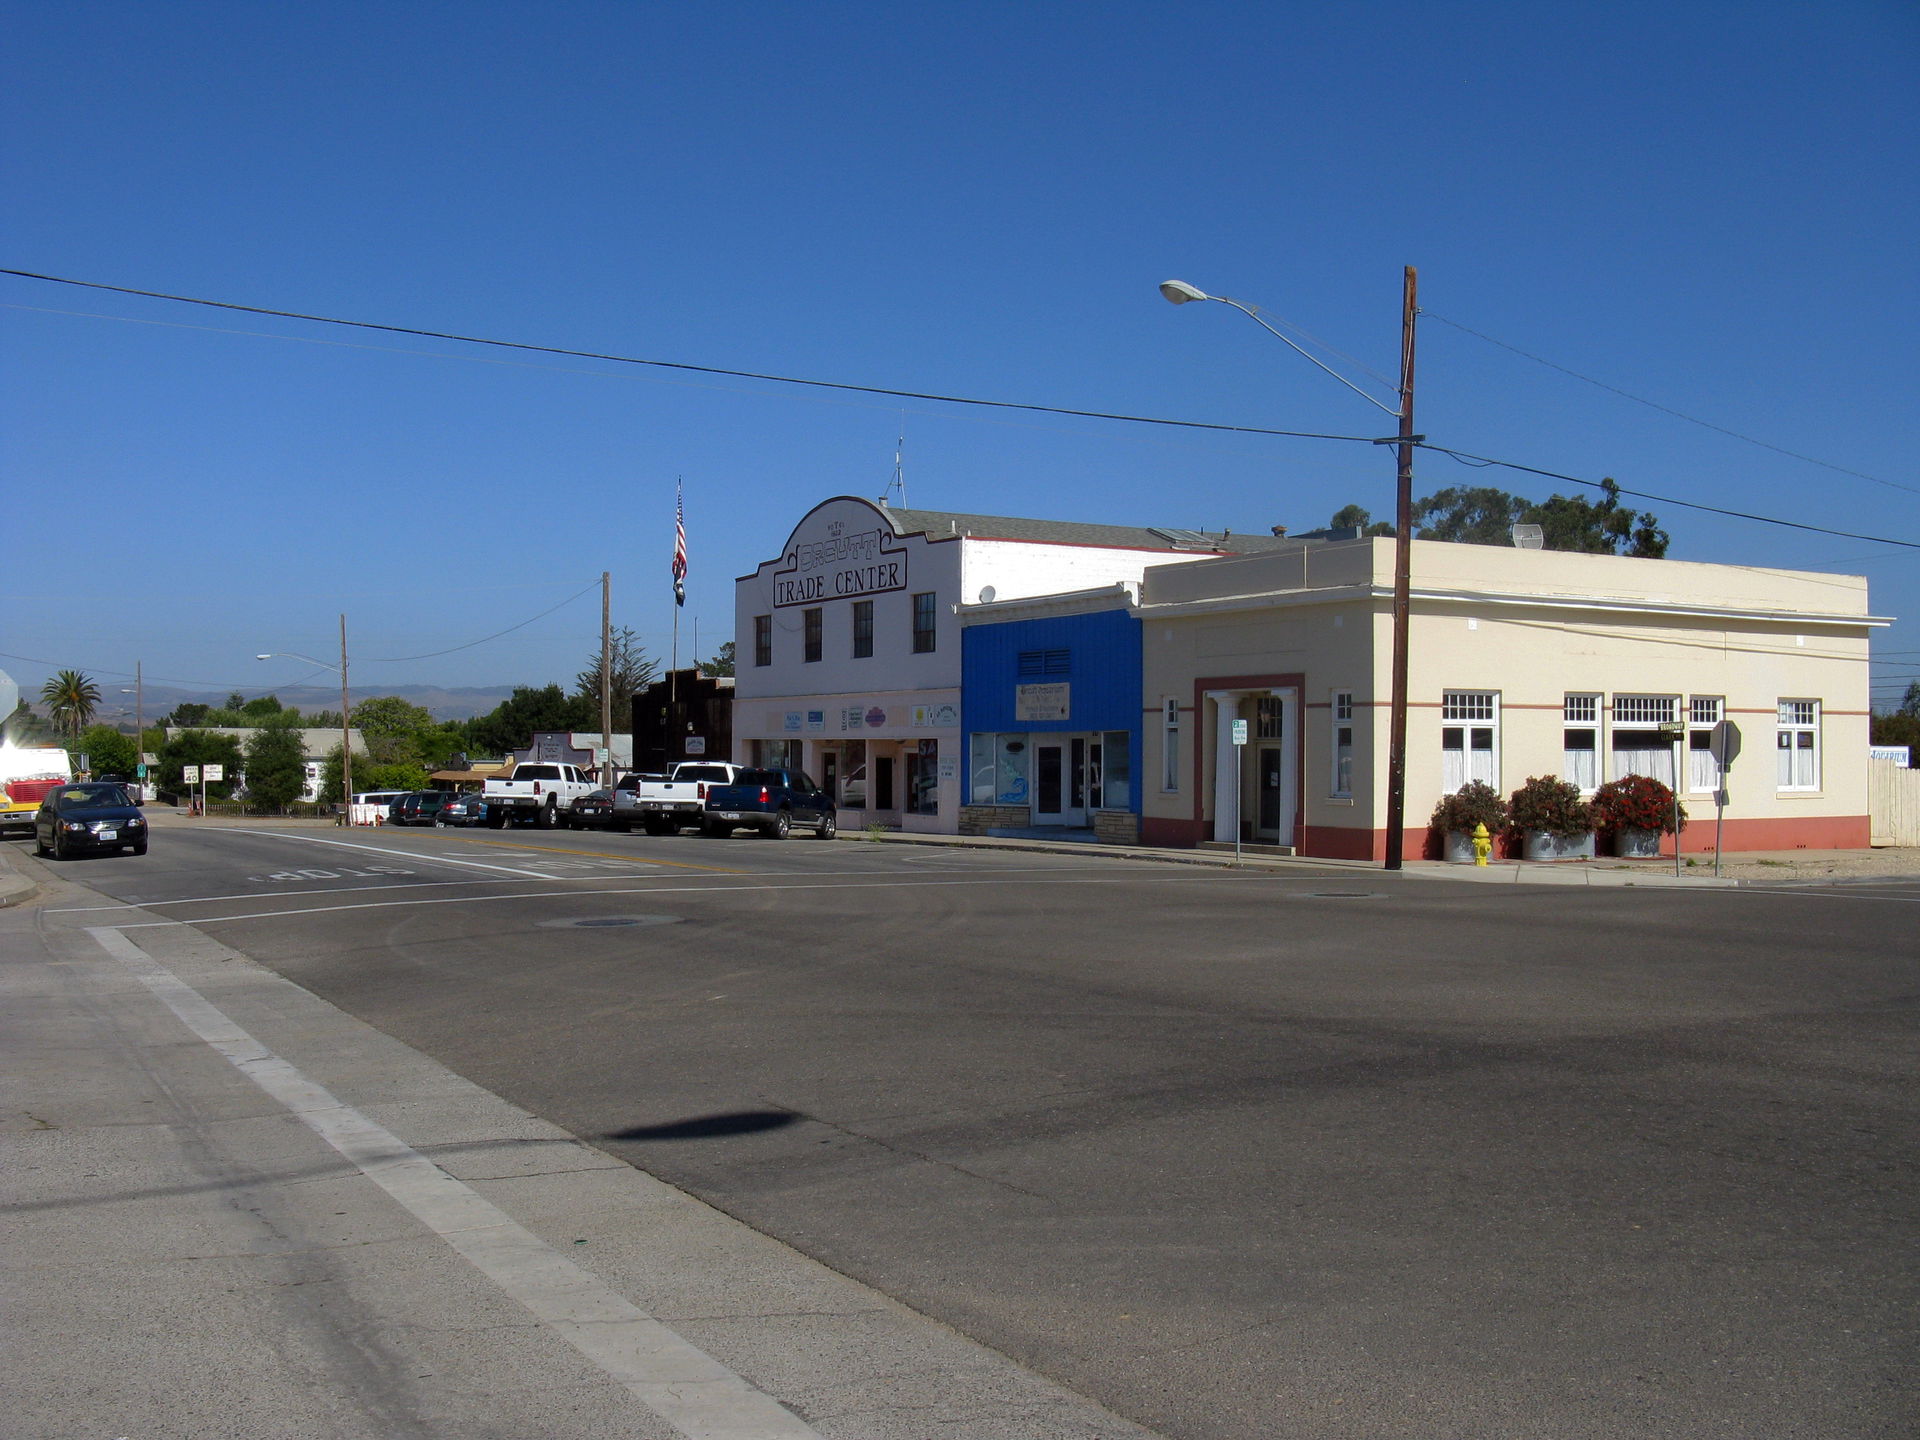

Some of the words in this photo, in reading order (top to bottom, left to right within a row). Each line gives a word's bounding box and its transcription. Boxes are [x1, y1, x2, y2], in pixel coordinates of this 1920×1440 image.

[778, 576, 825, 603] TRADE
[835, 563, 899, 594] CENTER
[266, 865, 416, 882] STOP
